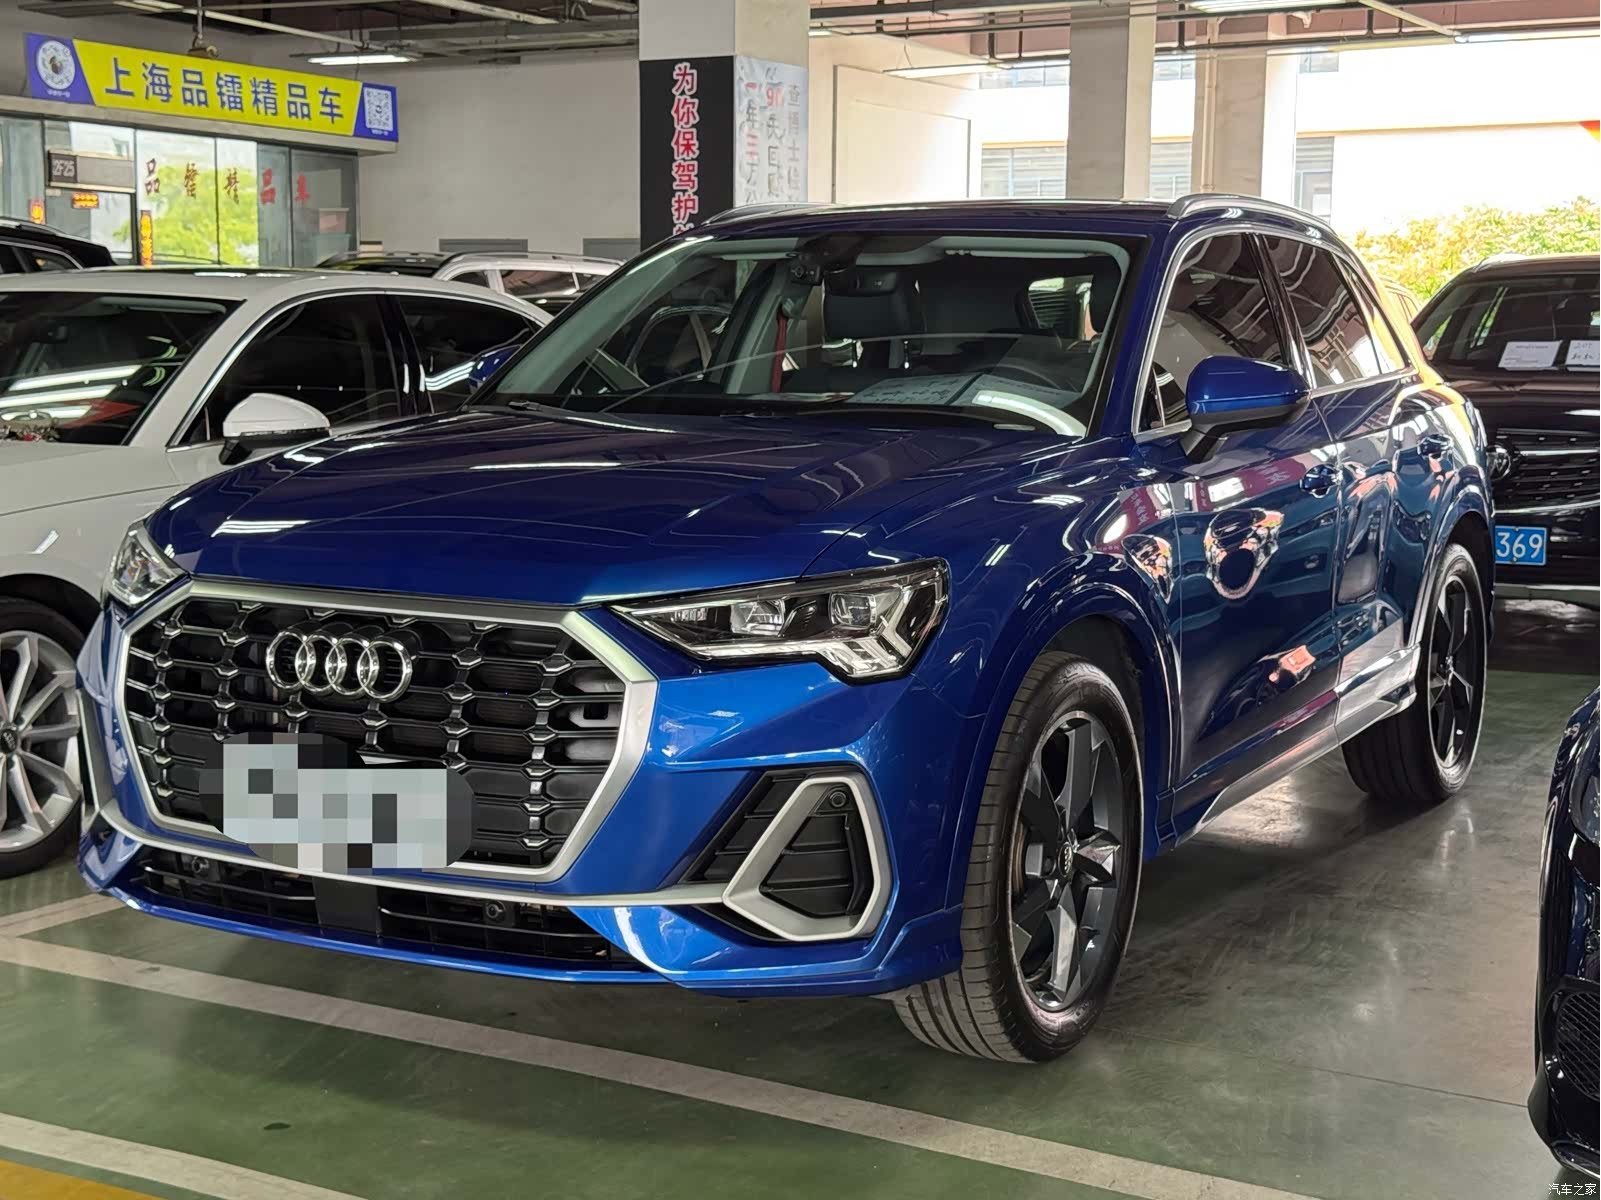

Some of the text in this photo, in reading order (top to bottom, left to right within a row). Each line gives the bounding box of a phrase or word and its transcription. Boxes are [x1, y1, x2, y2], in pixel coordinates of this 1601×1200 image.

[105, 57, 344, 124] 上海品镭精品车
[1496, 532, 1543, 559] 369
